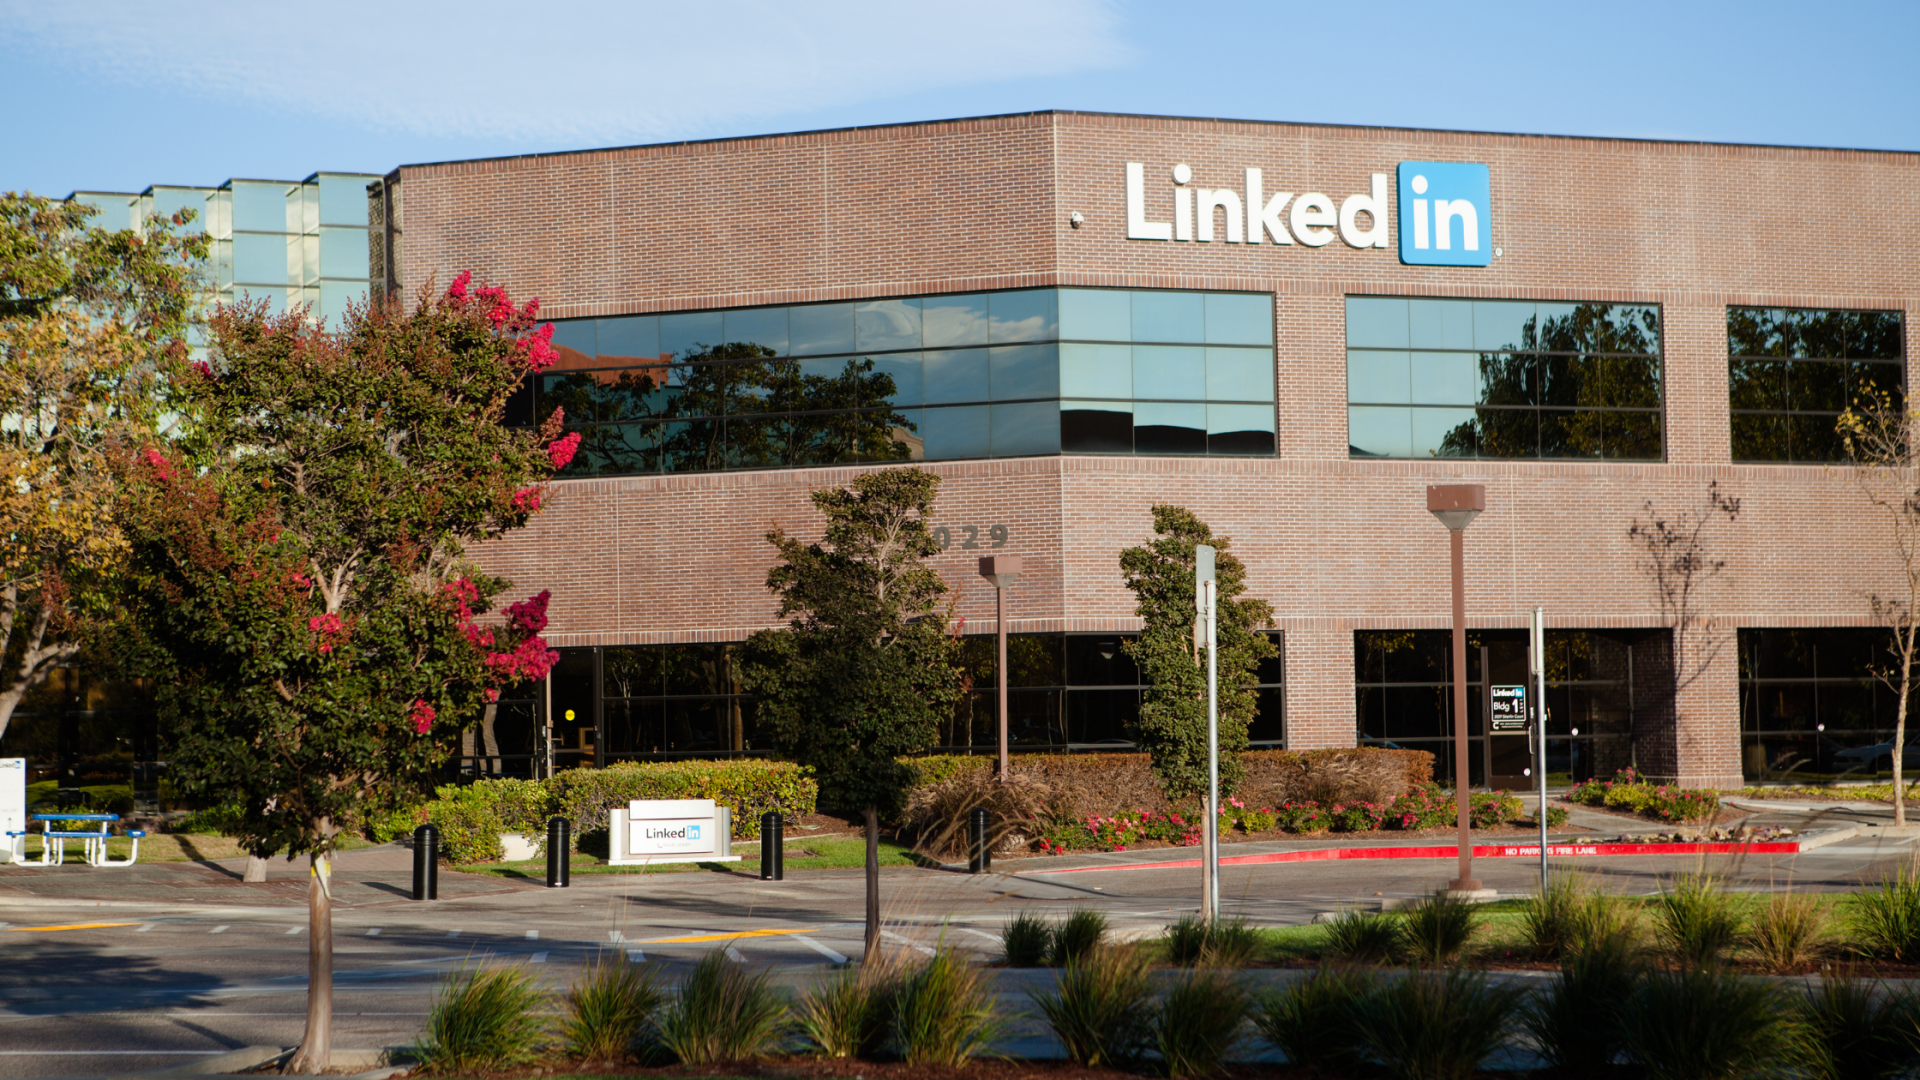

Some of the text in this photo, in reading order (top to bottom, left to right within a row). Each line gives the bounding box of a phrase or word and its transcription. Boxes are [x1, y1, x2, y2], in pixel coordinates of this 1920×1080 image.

[1493, 702, 1510, 712] Bldg
[1512, 698, 1519, 713] 1
[1505, 846, 1597, 856] NO PARKG FIRE LANE
